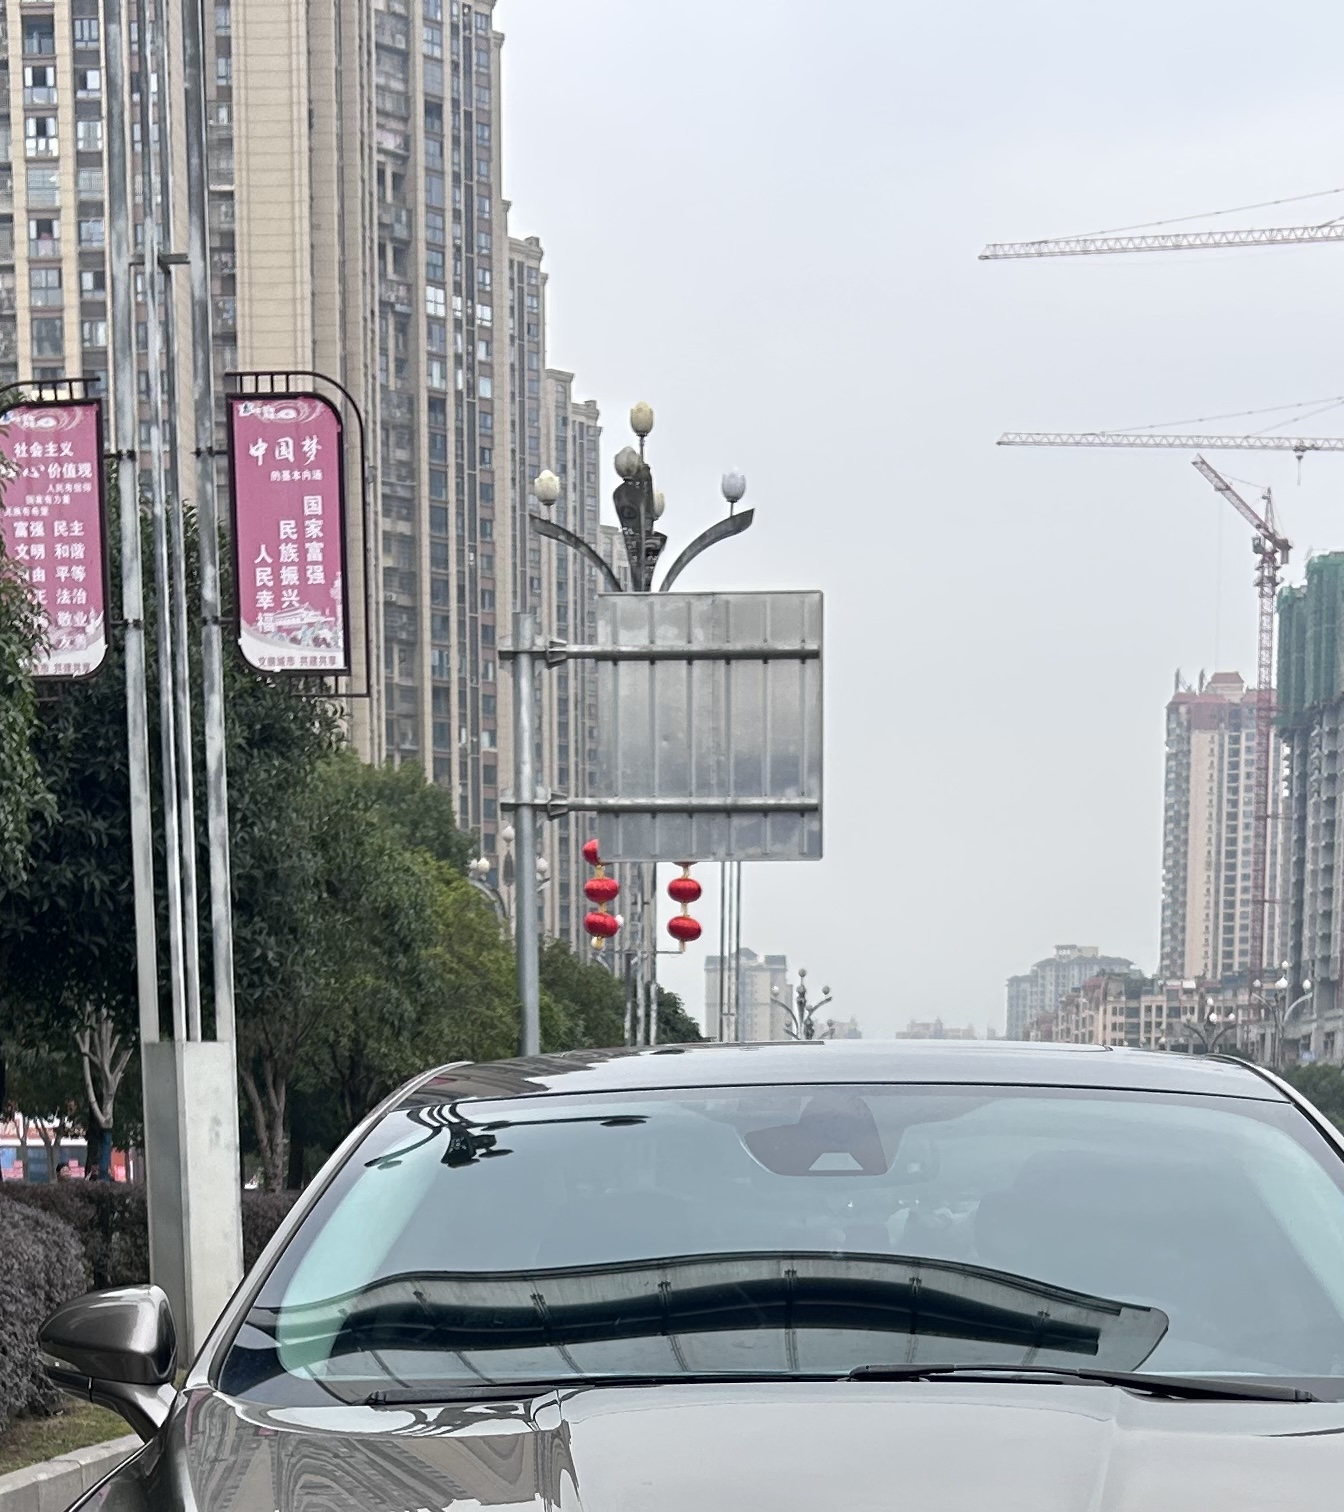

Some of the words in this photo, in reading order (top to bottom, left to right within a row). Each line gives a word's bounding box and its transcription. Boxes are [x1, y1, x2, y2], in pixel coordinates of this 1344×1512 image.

[13, 441, 74, 458] 社会主义
[249, 434, 323, 466] 中国梦
[13, 521, 46, 538] 富强
[53, 520, 85, 537] 民主
[304, 495, 325, 585] 国家富强
[14, 543, 46, 560] 文明
[54, 543, 85, 560] 和谐
[279, 519, 301, 609] 民族振兴
[55, 565, 86, 582] 平等
[56, 588, 87, 605] 法治
[254, 544, 276, 634] 人民幸福
